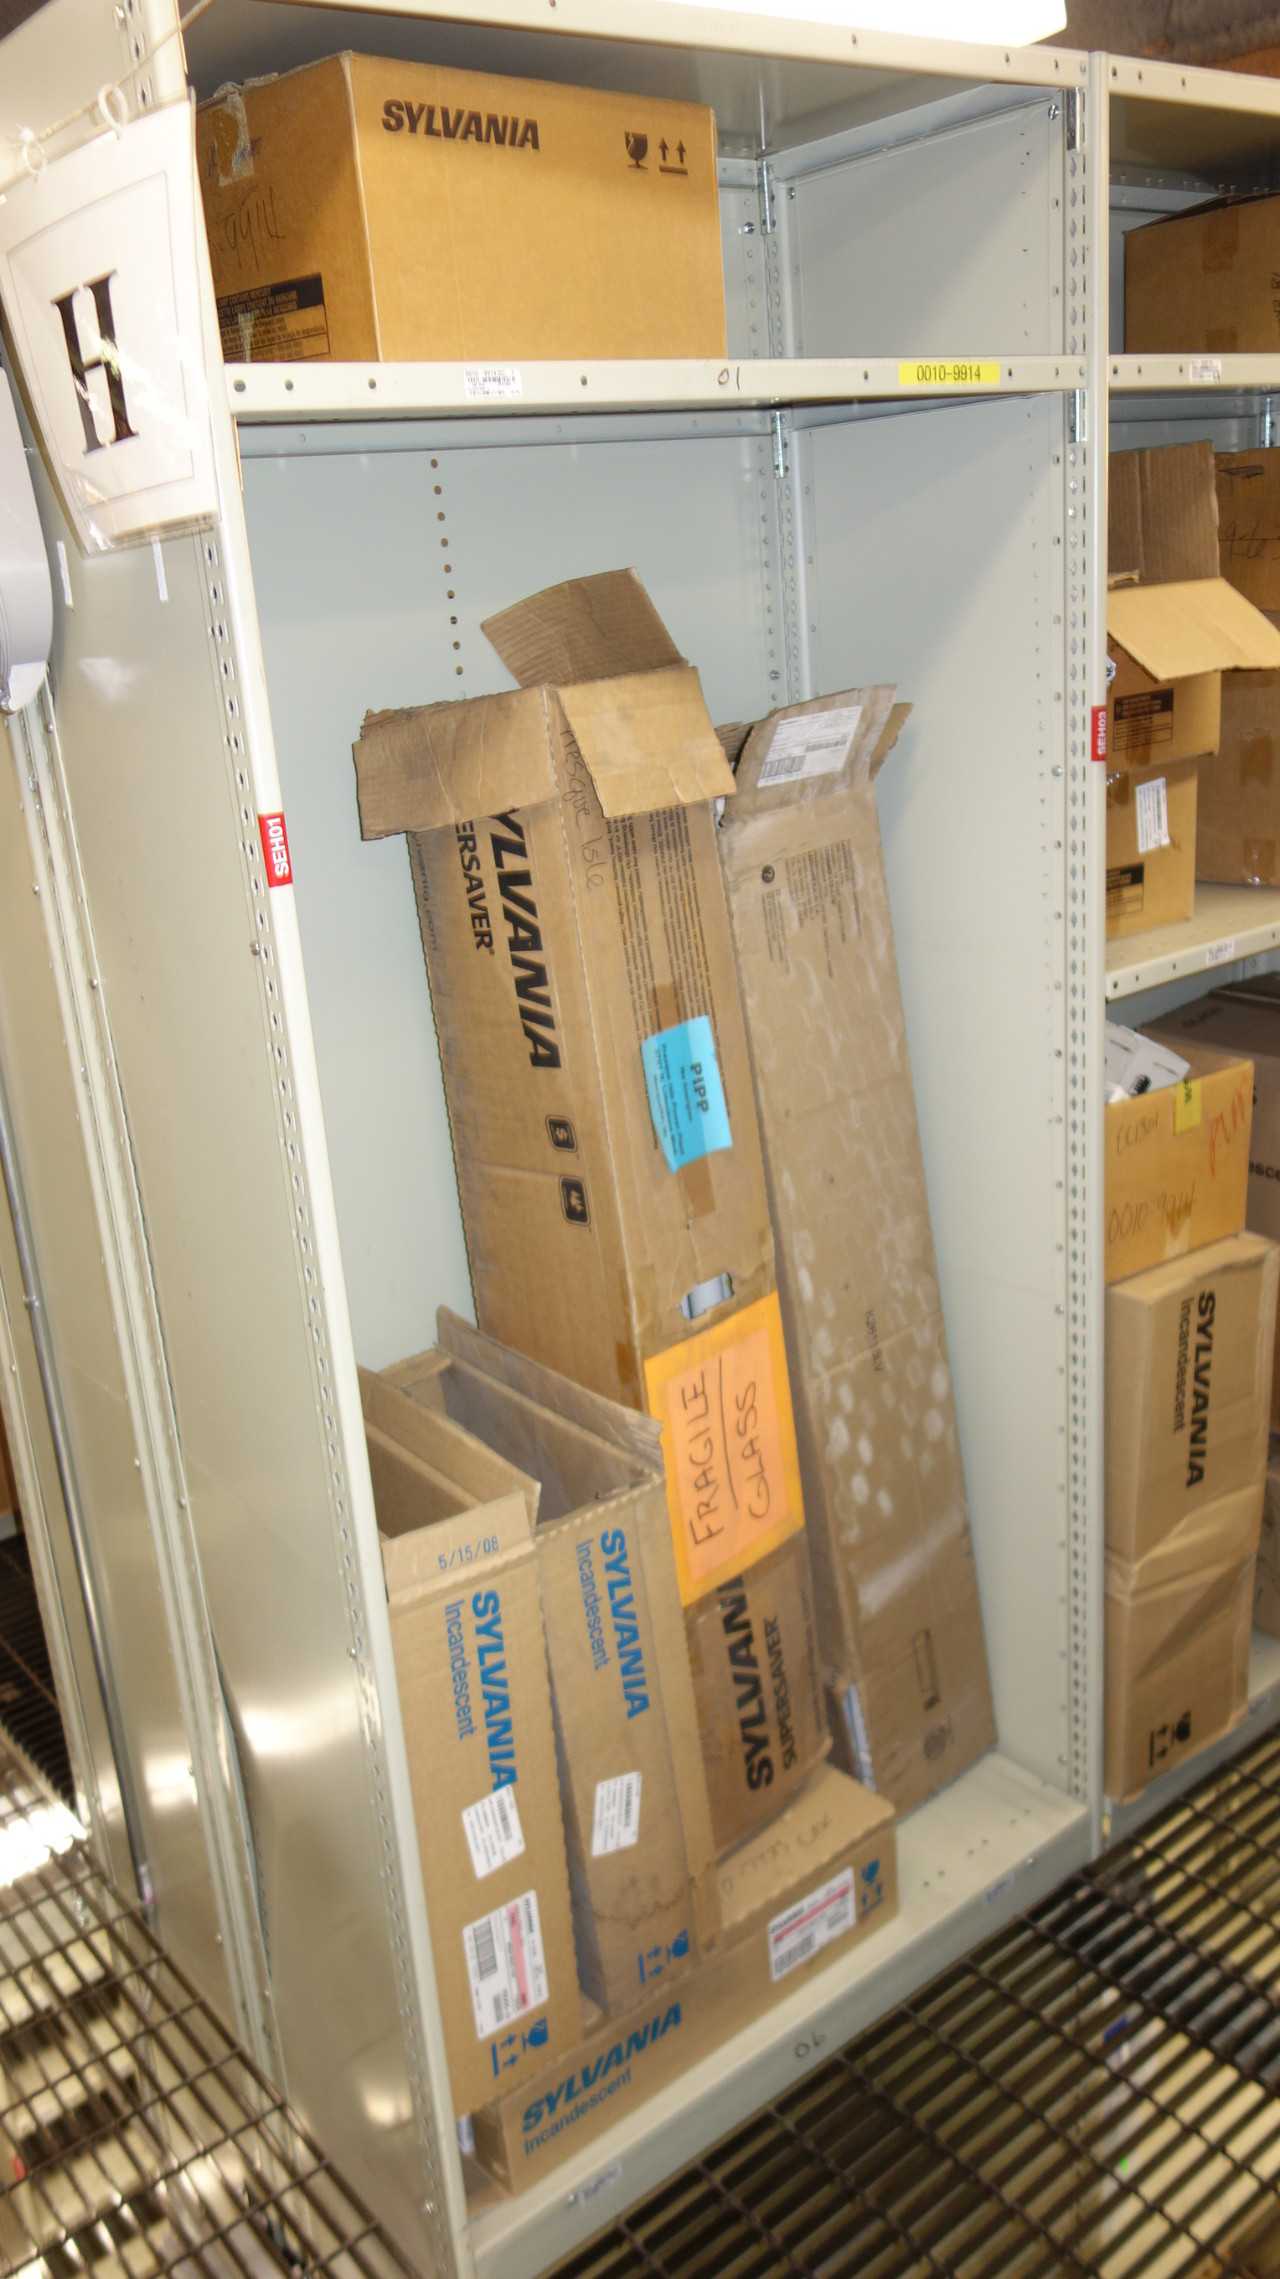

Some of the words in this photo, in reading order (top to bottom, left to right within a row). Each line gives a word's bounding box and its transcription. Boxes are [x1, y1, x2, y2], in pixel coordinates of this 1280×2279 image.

[382, 99, 540, 150] SYLVANIA
[50, 268, 140, 456] H
[916, 365, 981, 382] 0010-9914
[267, 817, 289, 879] SEH01
[455, 819, 493, 951] ERSAVER
[489, 807, 562, 1069] YLVANIA
[691, 1061, 710, 1113] PIPP
[1173, 1297, 1195, 1435] Incandescent
[1186, 1289, 1216, 1488] SYLVANIA
[681, 1370, 725, 1546] FRAGILE
[736, 1380, 771, 1519] GLASS
[445, 1598, 478, 1741] Incandescent
[576, 1536, 611, 1671] Incandescent
[600, 1527, 650, 1720] SYLVANIA
[471, 1589, 518, 1792] SYLVANIA
[716, 1574, 774, 1790] SYLVANI
[764, 1616, 797, 1771] SUPERSAVER
[522, 2001, 682, 2133] SYLVANIA
[524, 2068, 632, 2157] Incandescent
